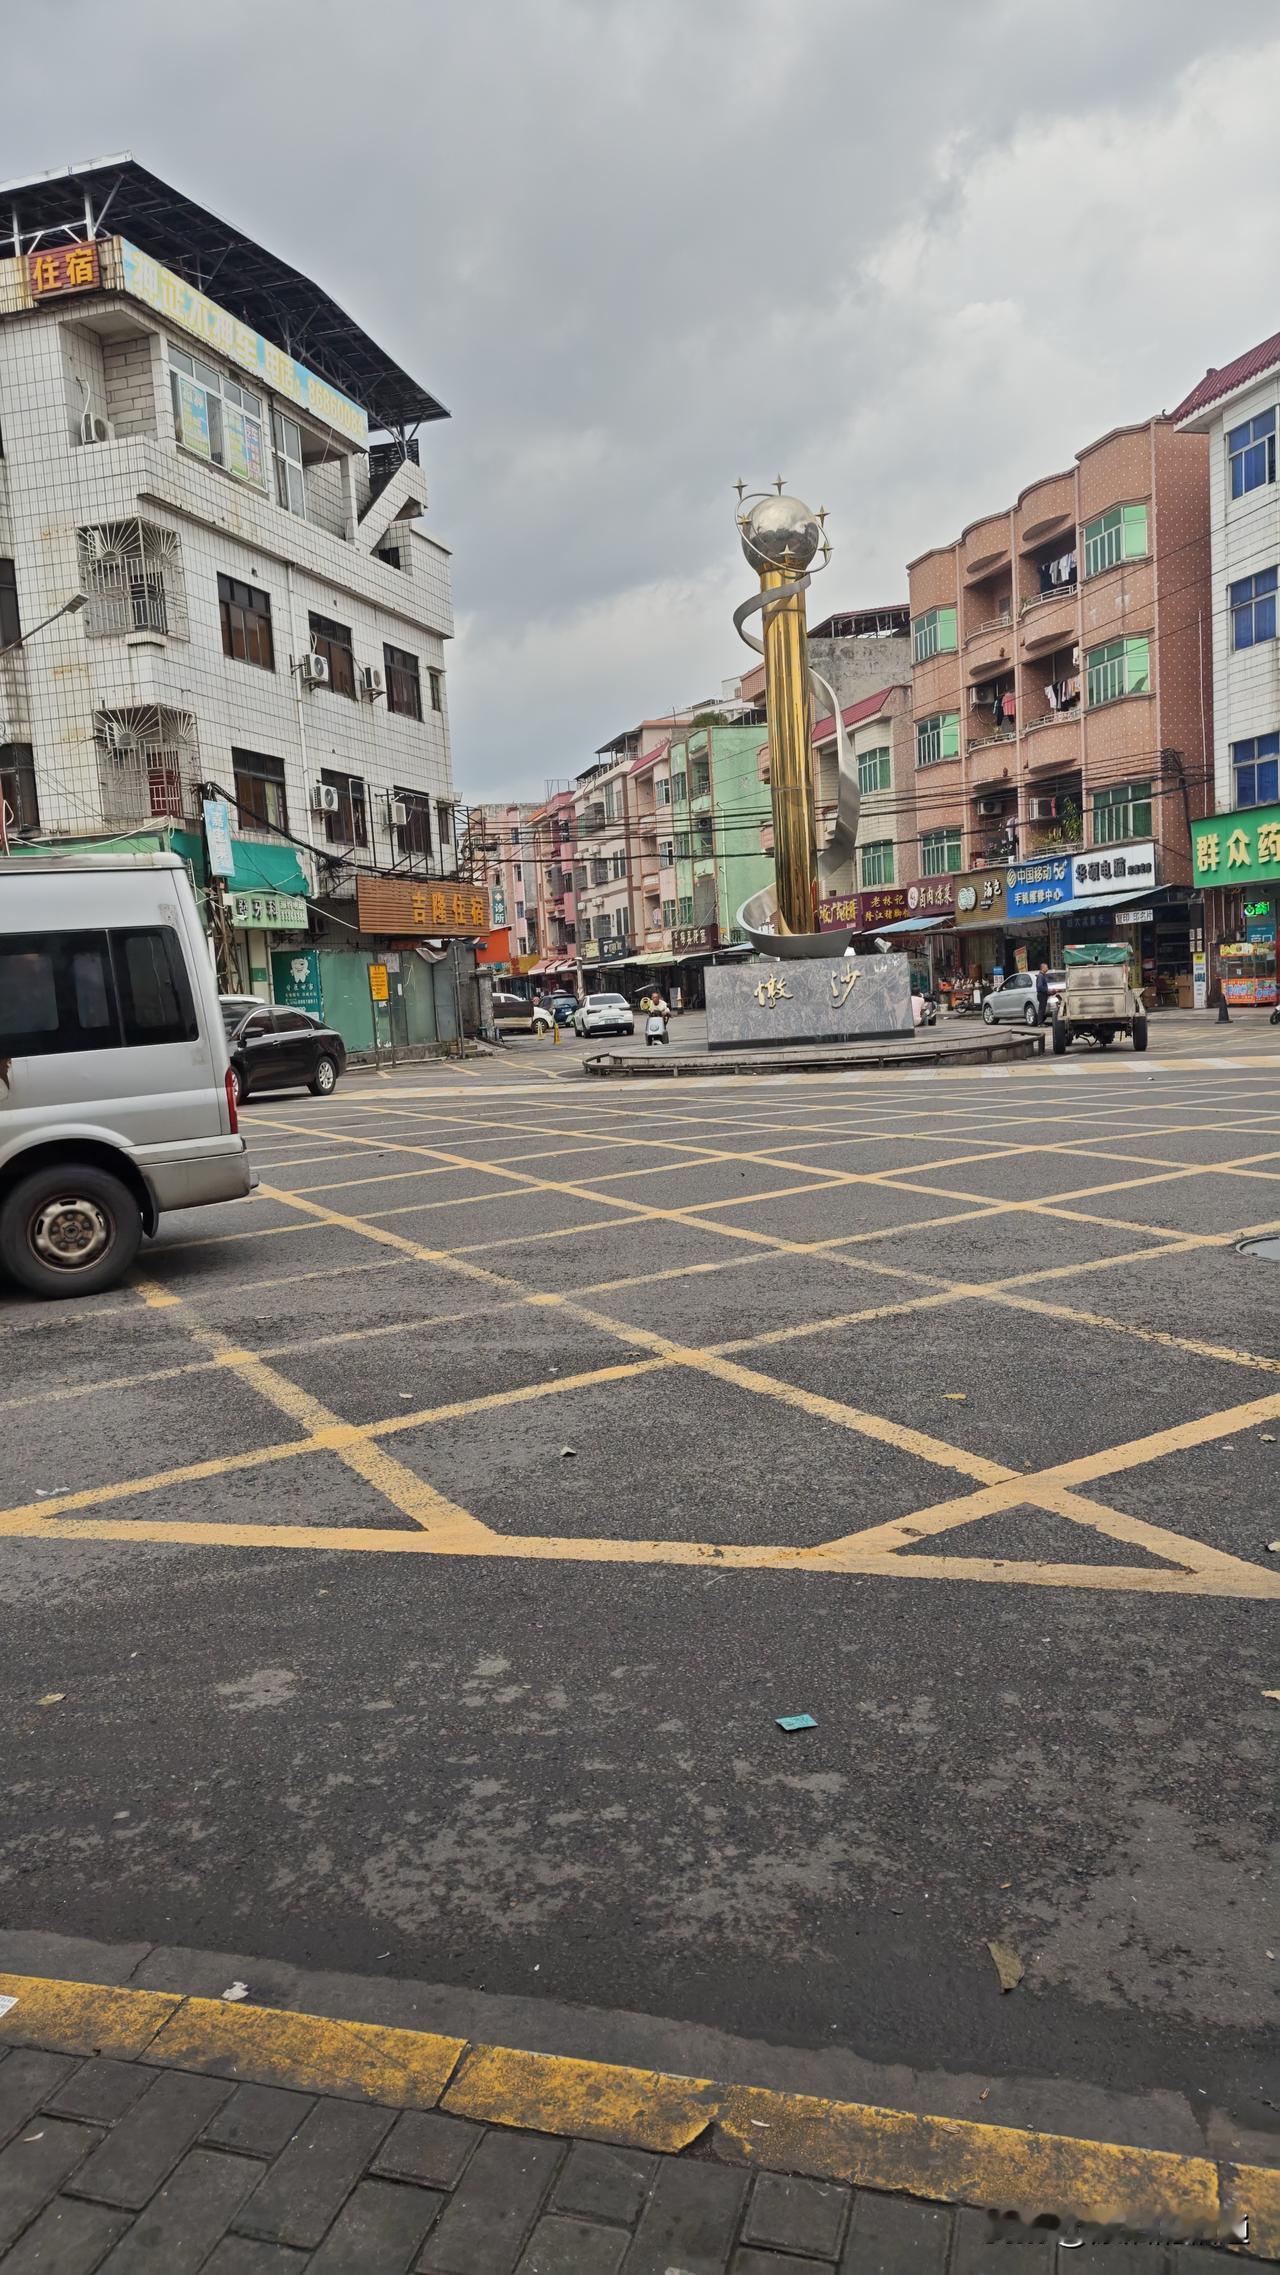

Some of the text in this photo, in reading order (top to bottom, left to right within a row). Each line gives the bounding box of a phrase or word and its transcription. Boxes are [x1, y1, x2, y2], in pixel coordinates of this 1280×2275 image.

[32, 248, 94, 292] 住宿
[1017, 865, 1052, 885] 中国移动
[1076, 857, 1126, 883] 华硕电脑
[871, 894, 905, 908] 老林记
[1014, 887, 1064, 906] 手机维修中心
[412, 891, 484, 926] 吉隆住宿
[494, 903, 505, 924] 诊所
